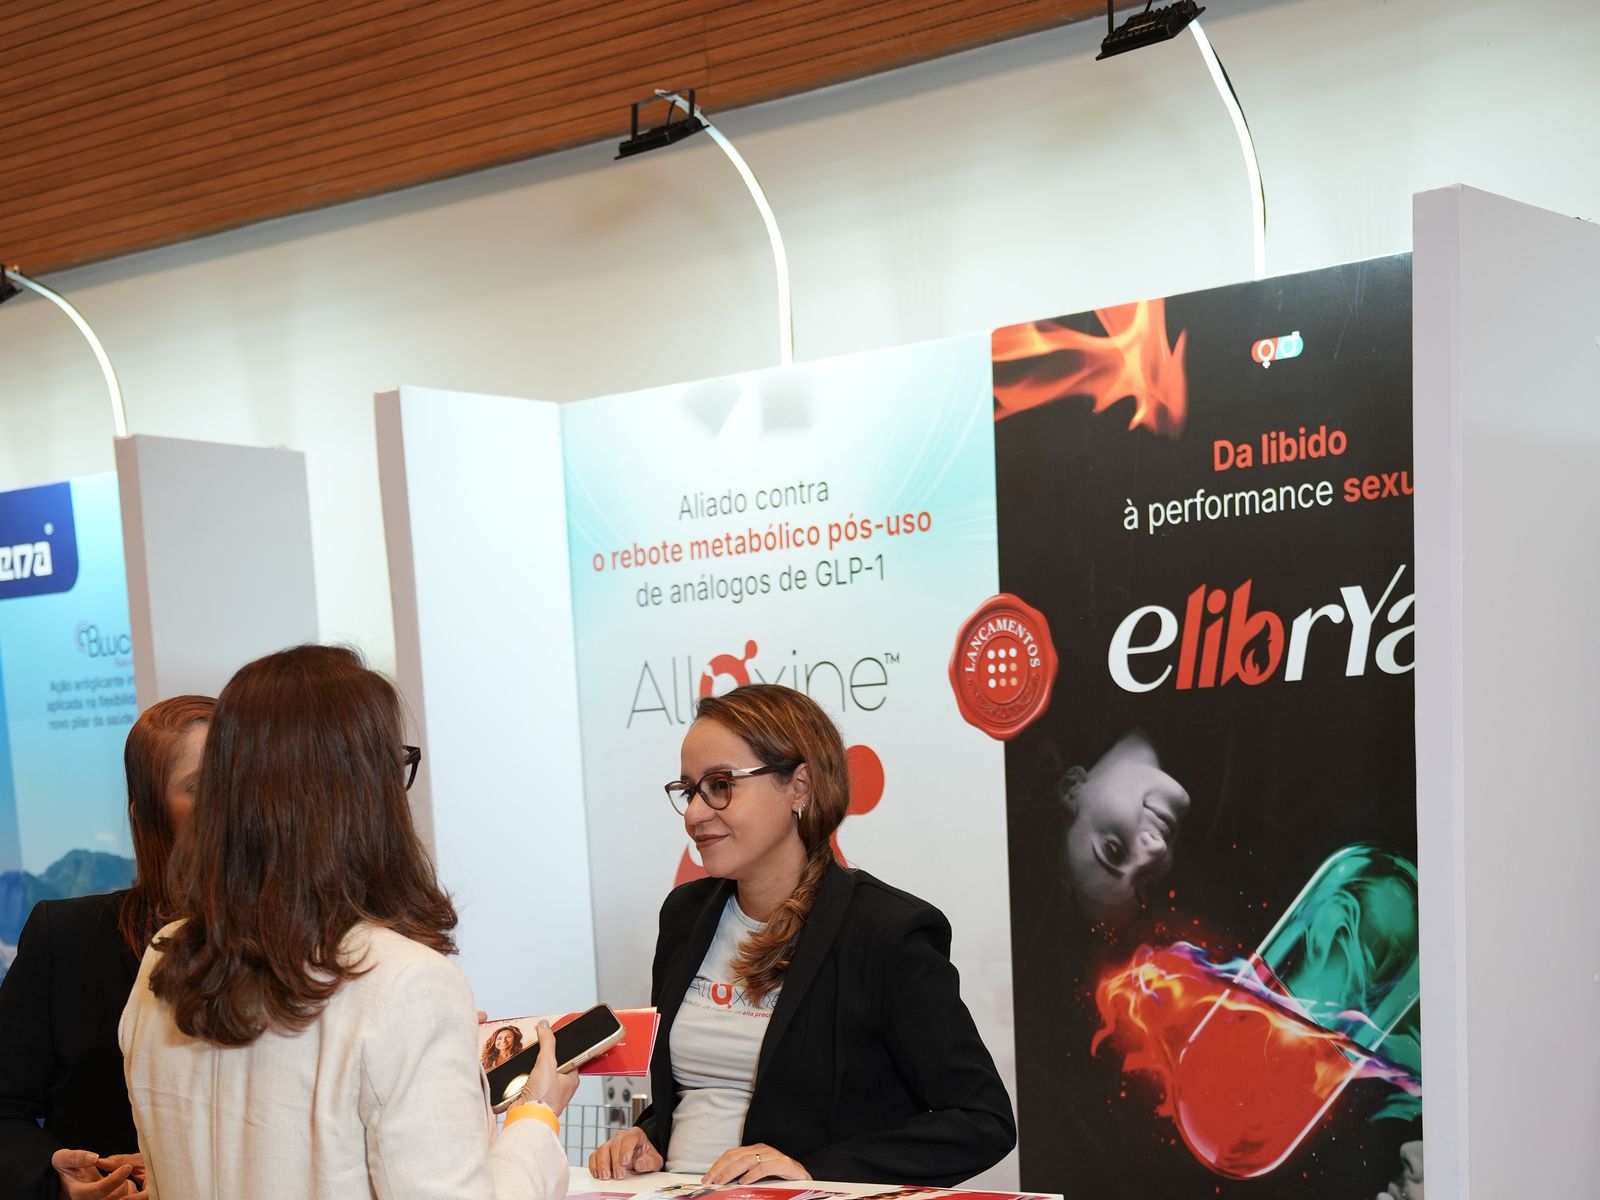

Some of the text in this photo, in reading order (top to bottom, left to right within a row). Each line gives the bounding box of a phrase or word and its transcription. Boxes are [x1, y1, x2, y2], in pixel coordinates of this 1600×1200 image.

[1213, 425, 1348, 471] Da libido
[679, 480, 830, 521] Aliado contra
[1123, 499, 1139, 530] à
[1148, 481, 1334, 535] performance
[592, 510, 932, 572] o rebote metabólico pós-uso
[636, 554, 885, 607] de análogos de GLP-1
[965, 618, 1041, 673] LANÇAMENTOS
